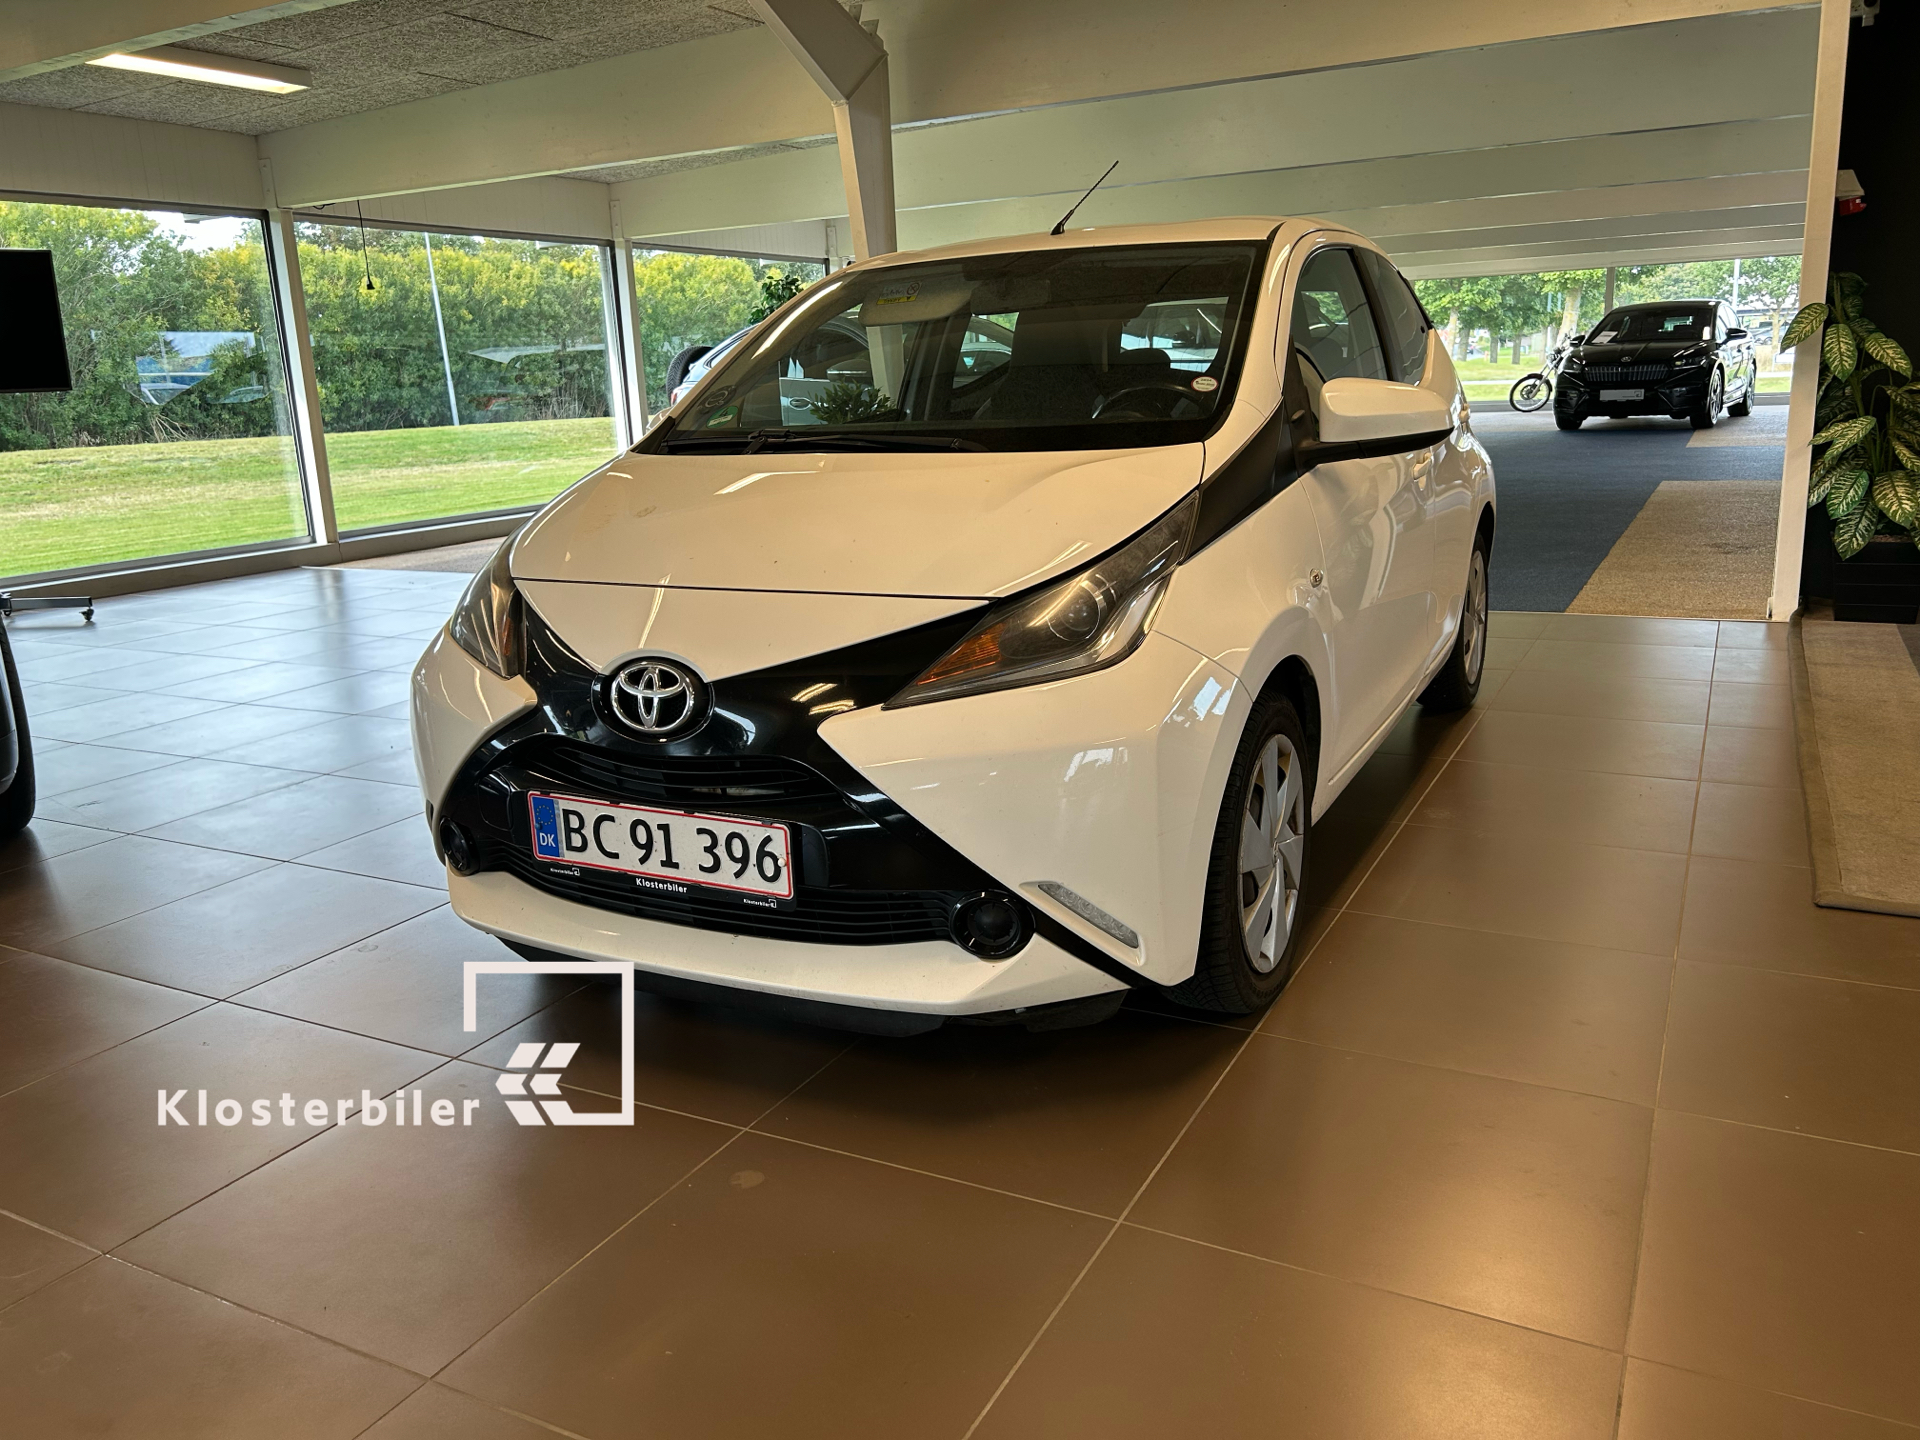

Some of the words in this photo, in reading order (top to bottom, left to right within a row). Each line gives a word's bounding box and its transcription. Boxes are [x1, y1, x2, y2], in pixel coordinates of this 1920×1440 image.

[539, 832, 556, 847] DK
[562, 808, 620, 860] BC
[629, 818, 680, 870] 91
[696, 827, 782, 883] 396
[635, 877, 688, 893] Klosterbiler
